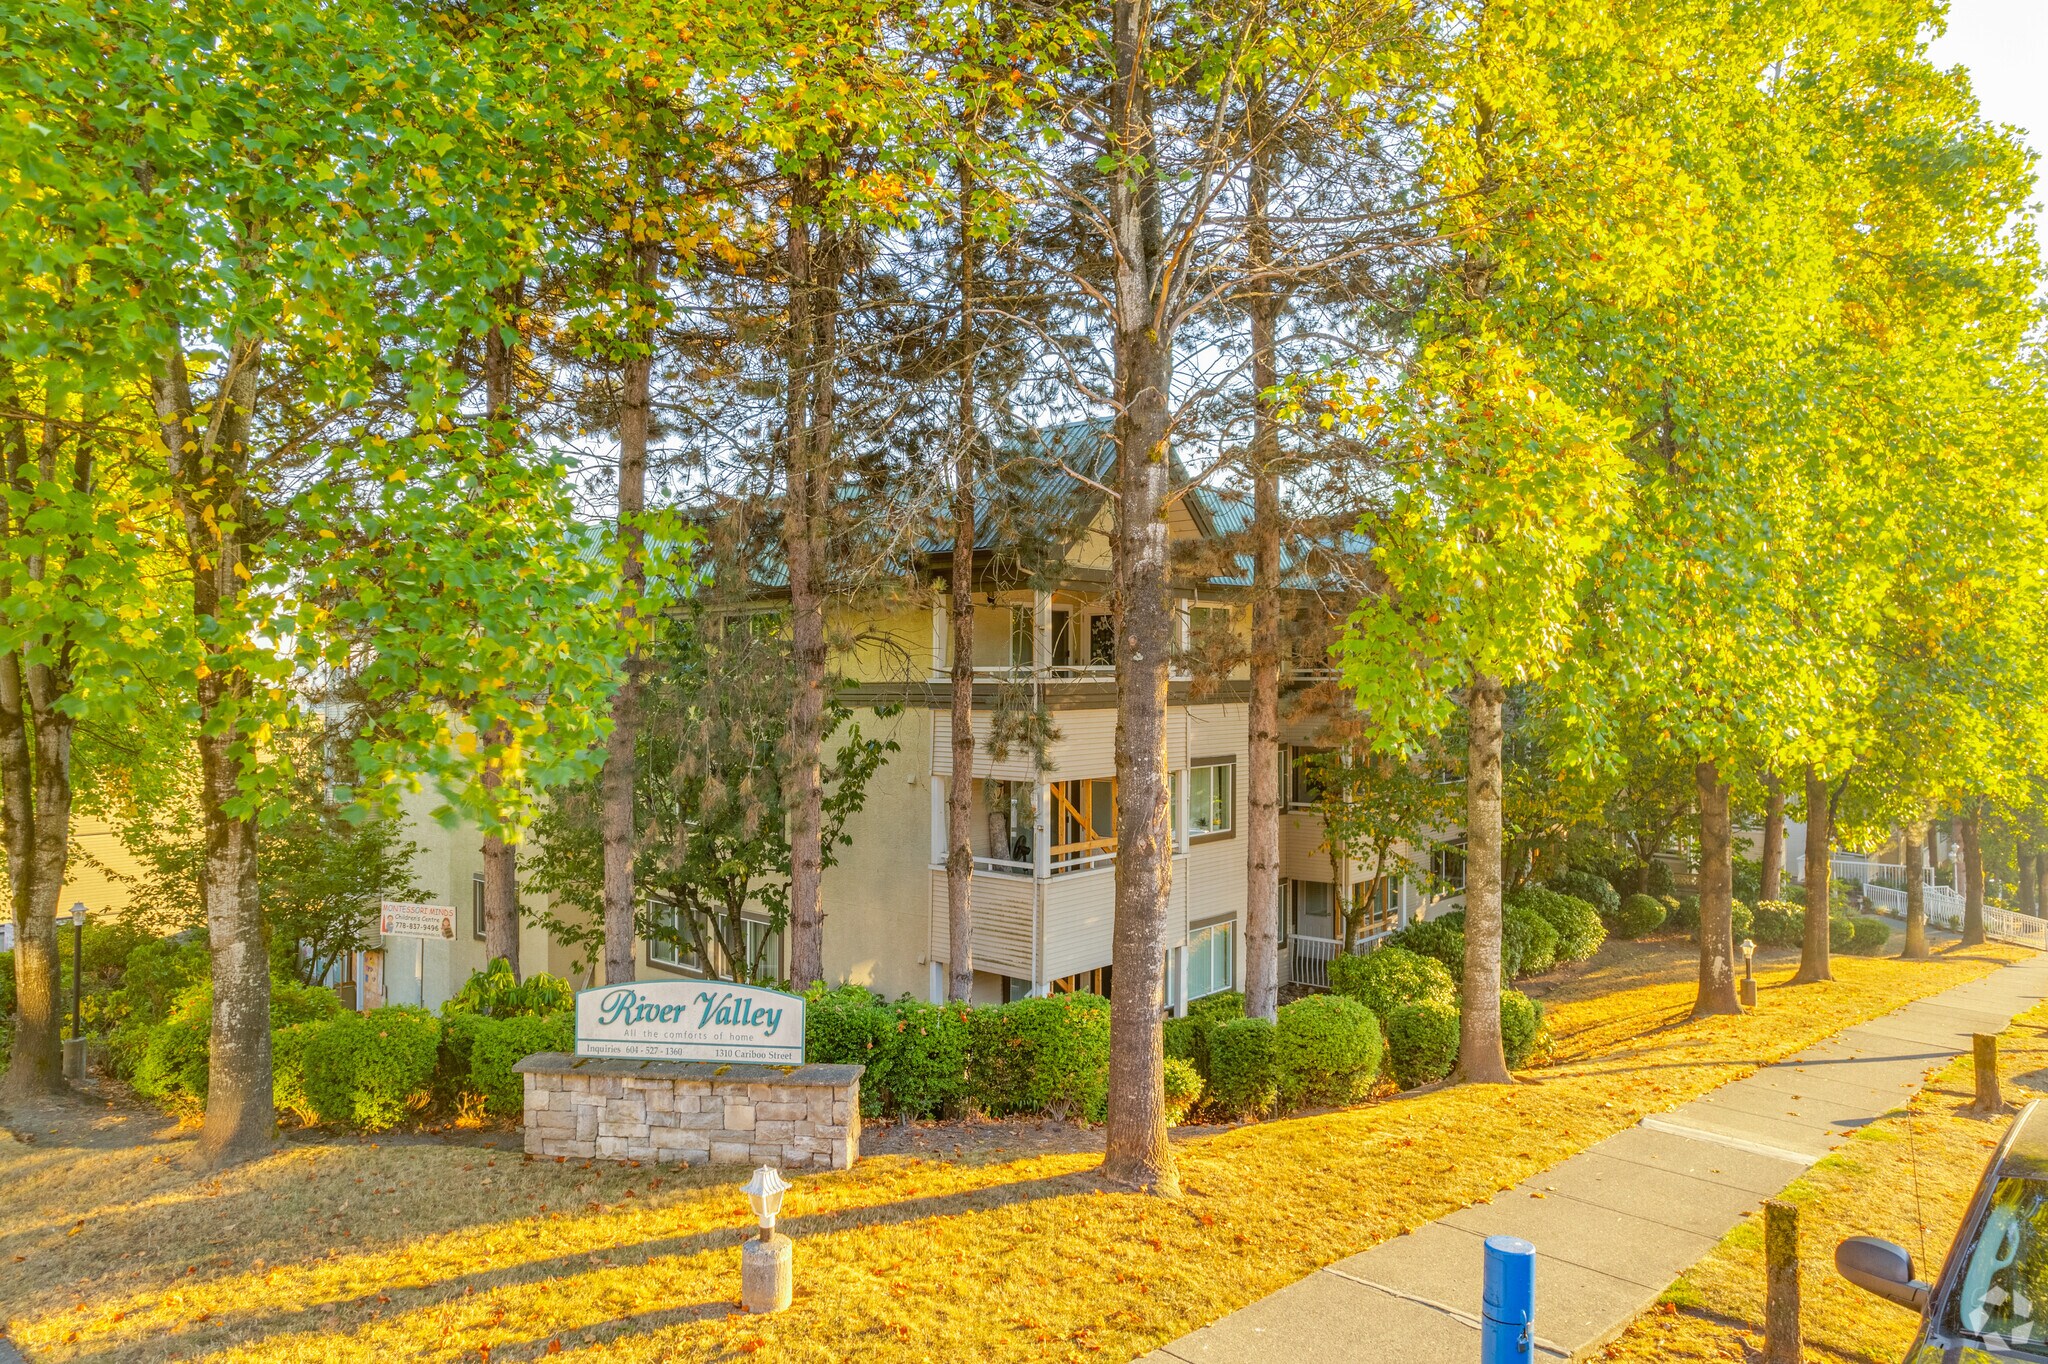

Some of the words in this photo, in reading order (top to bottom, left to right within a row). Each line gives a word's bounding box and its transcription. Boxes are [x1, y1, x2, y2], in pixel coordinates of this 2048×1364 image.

[383, 904, 428, 914] MONTESSORI
[429, 908, 454, 916] MINDS
[396, 922, 439, 932] 778-837-9496
[598, 989, 686, 1026] River
[693, 992, 782, 1037] Valley
[624, 1030, 637, 1038] All
[643, 1030, 658, 1038] the
[664, 1030, 708, 1040] comforts
[714, 1032, 724, 1040] of
[729, 1032, 754, 1042] home
[586, 1044, 622, 1054] Inquiries
[625, 1046, 638, 1054] 604
[646, 1046, 658, 1055] 527
[666, 1047, 683, 1056] 1360
[715, 1048, 733, 1058] 1310
[734, 1050, 766, 1059] Cariboo
[768, 1051, 793, 1060] Street
